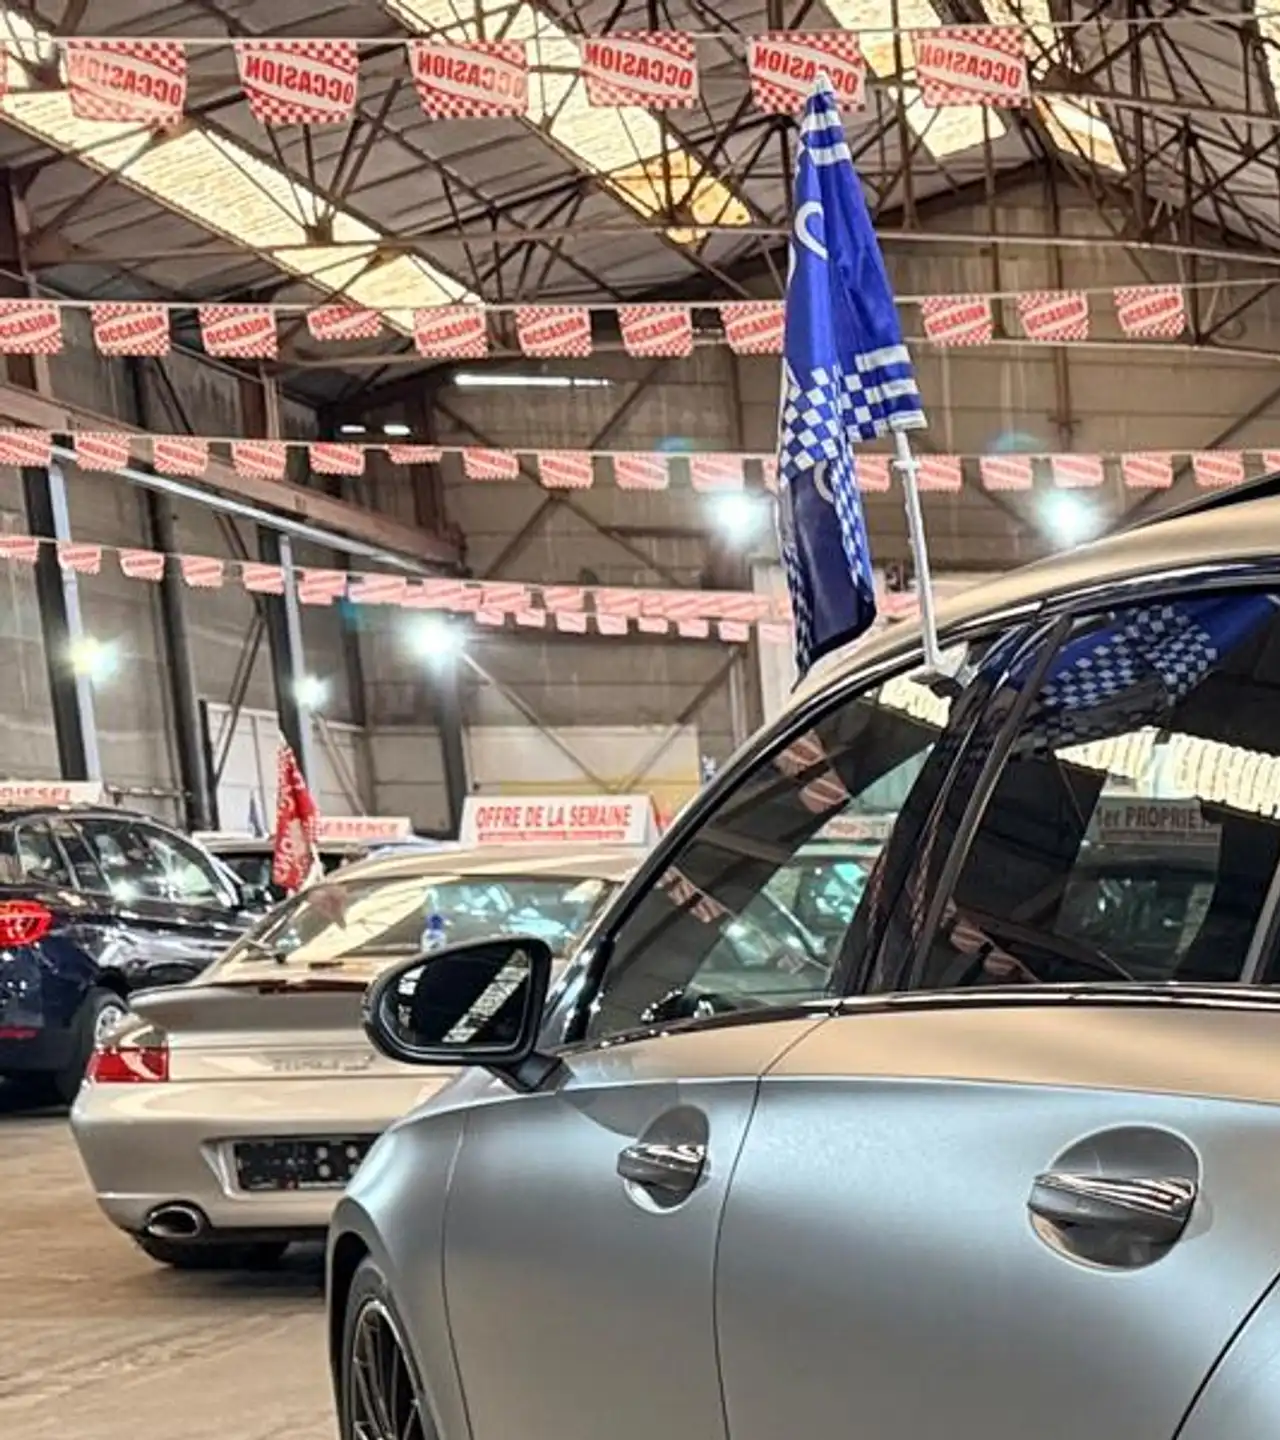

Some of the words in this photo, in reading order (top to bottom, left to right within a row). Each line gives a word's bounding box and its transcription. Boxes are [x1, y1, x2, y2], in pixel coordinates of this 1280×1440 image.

[0, 313, 57, 338] CCASION
[99, 315, 166, 343] OCCASION
[205, 315, 271, 344] OCCASION
[476, 805, 521, 829] OFFRE
[525, 805, 544, 828] DE
[549, 804, 565, 828] LA
[569, 803, 633, 828] SEMAINE
